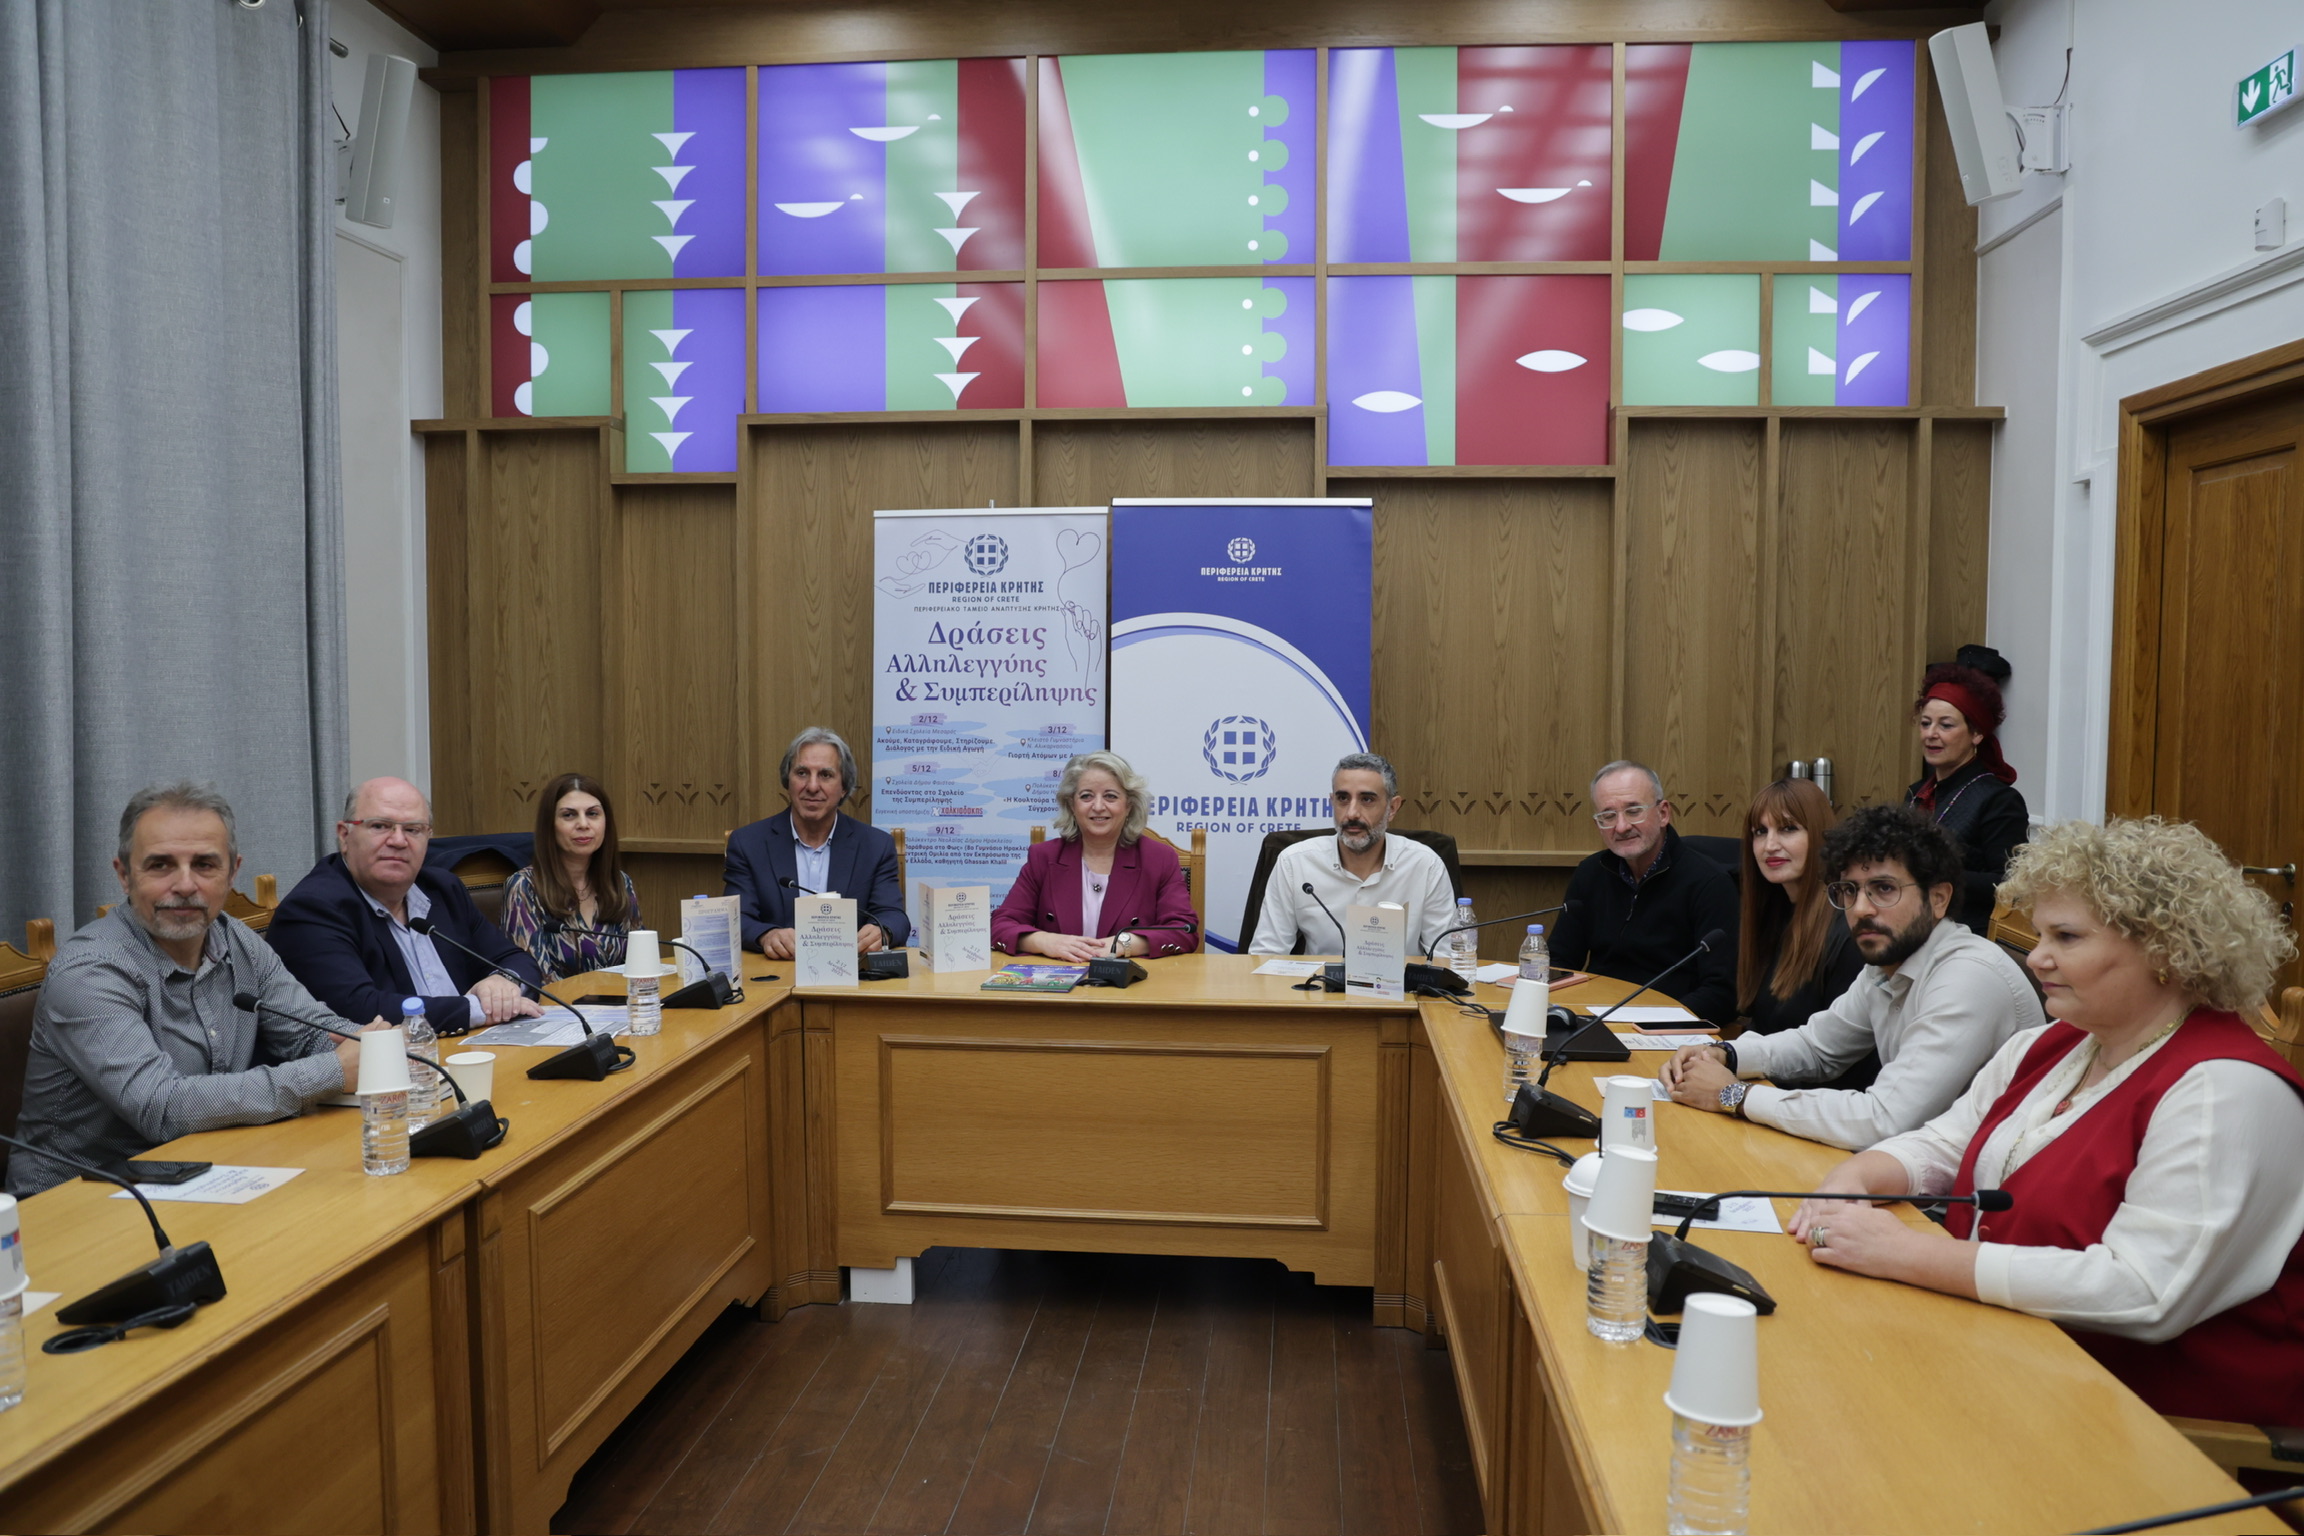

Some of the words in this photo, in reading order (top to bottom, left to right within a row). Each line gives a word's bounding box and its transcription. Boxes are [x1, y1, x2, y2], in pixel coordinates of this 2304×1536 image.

[1200, 567, 1250, 576] ΠΕΡΙΦΕΡΕΙΑ
[1251, 567, 1282, 576] ΚΡΗΤΗΣ
[928, 581, 997, 594] ΠΕΡΙΦΕΡΕΙΑ
[1000, 580, 1044, 593] ΚΡΗΤΗΣ
[928, 620, 1047, 651] Δράσεις
[885, 653, 1047, 678] Αλληλεγγύης
[895, 677, 918, 702] &
[924, 680, 1097, 706] Συμπερίληψης
[1048, 726, 1067, 734] 3/12
[912, 764, 932, 772] 5/12
[1148, 796, 1259, 817] ΕΡΙΦΕΡΕΙΑ
[1267, 797, 1334, 818] ΚΡΗΤΗ
[1176, 822, 1232, 832] REGION
[1236, 822, 1254, 833] OF
[1260, 822, 1301, 832] CRETE
[1093, 966, 1122, 975] TAIDEN
